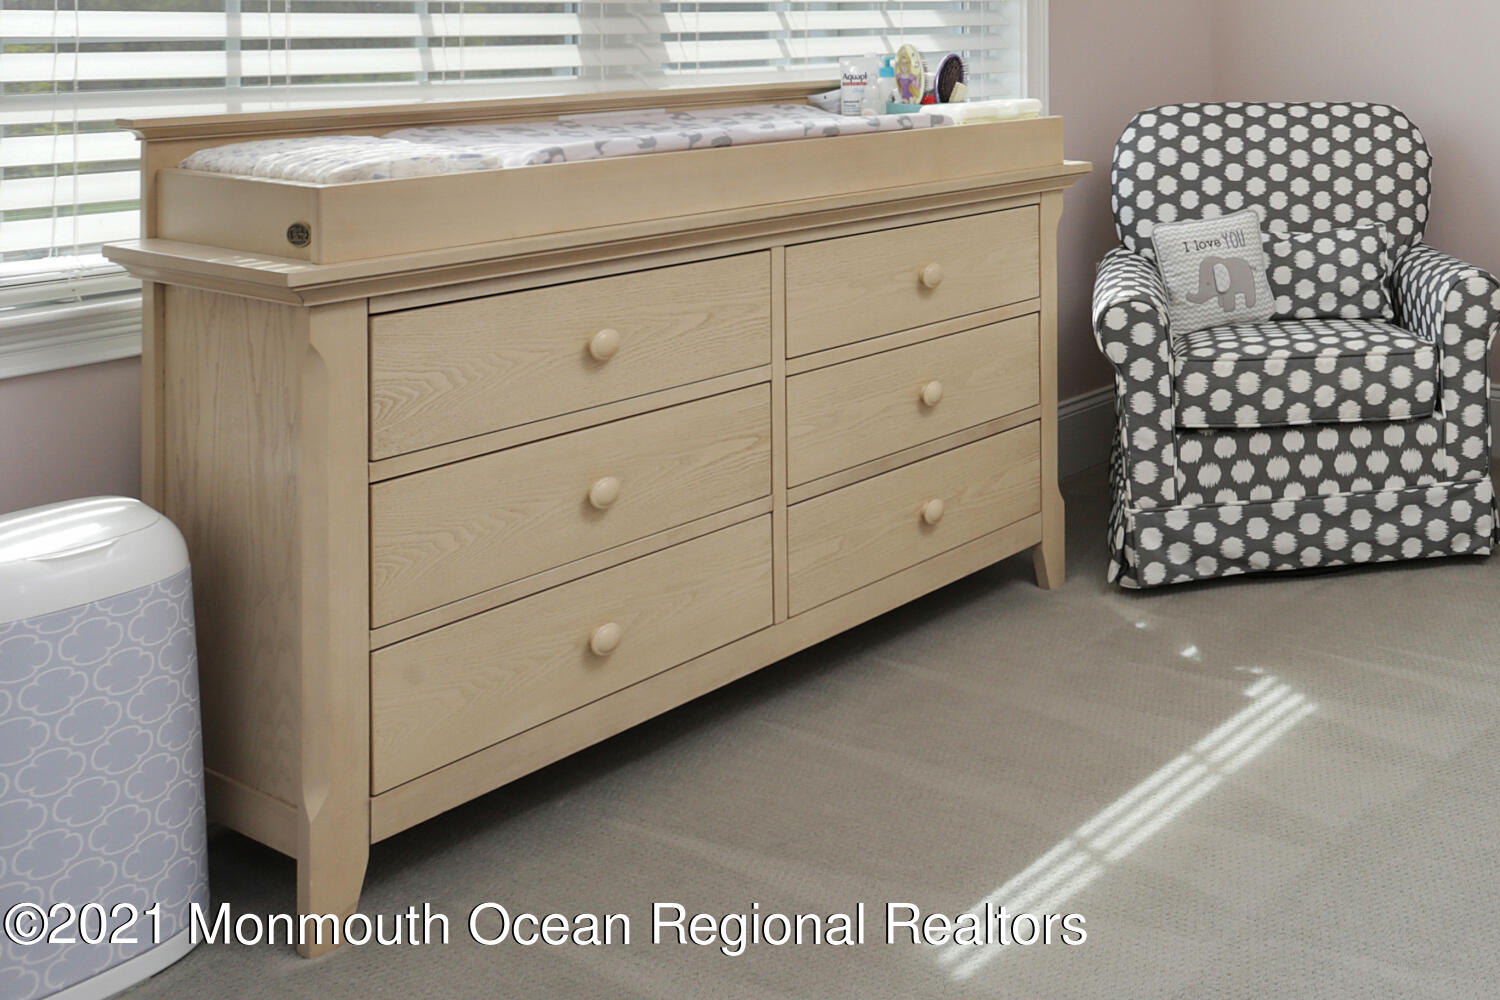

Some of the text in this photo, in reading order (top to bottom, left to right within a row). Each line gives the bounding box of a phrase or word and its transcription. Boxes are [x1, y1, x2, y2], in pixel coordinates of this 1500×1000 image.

[1183, 230, 1246, 253] I love YOU
